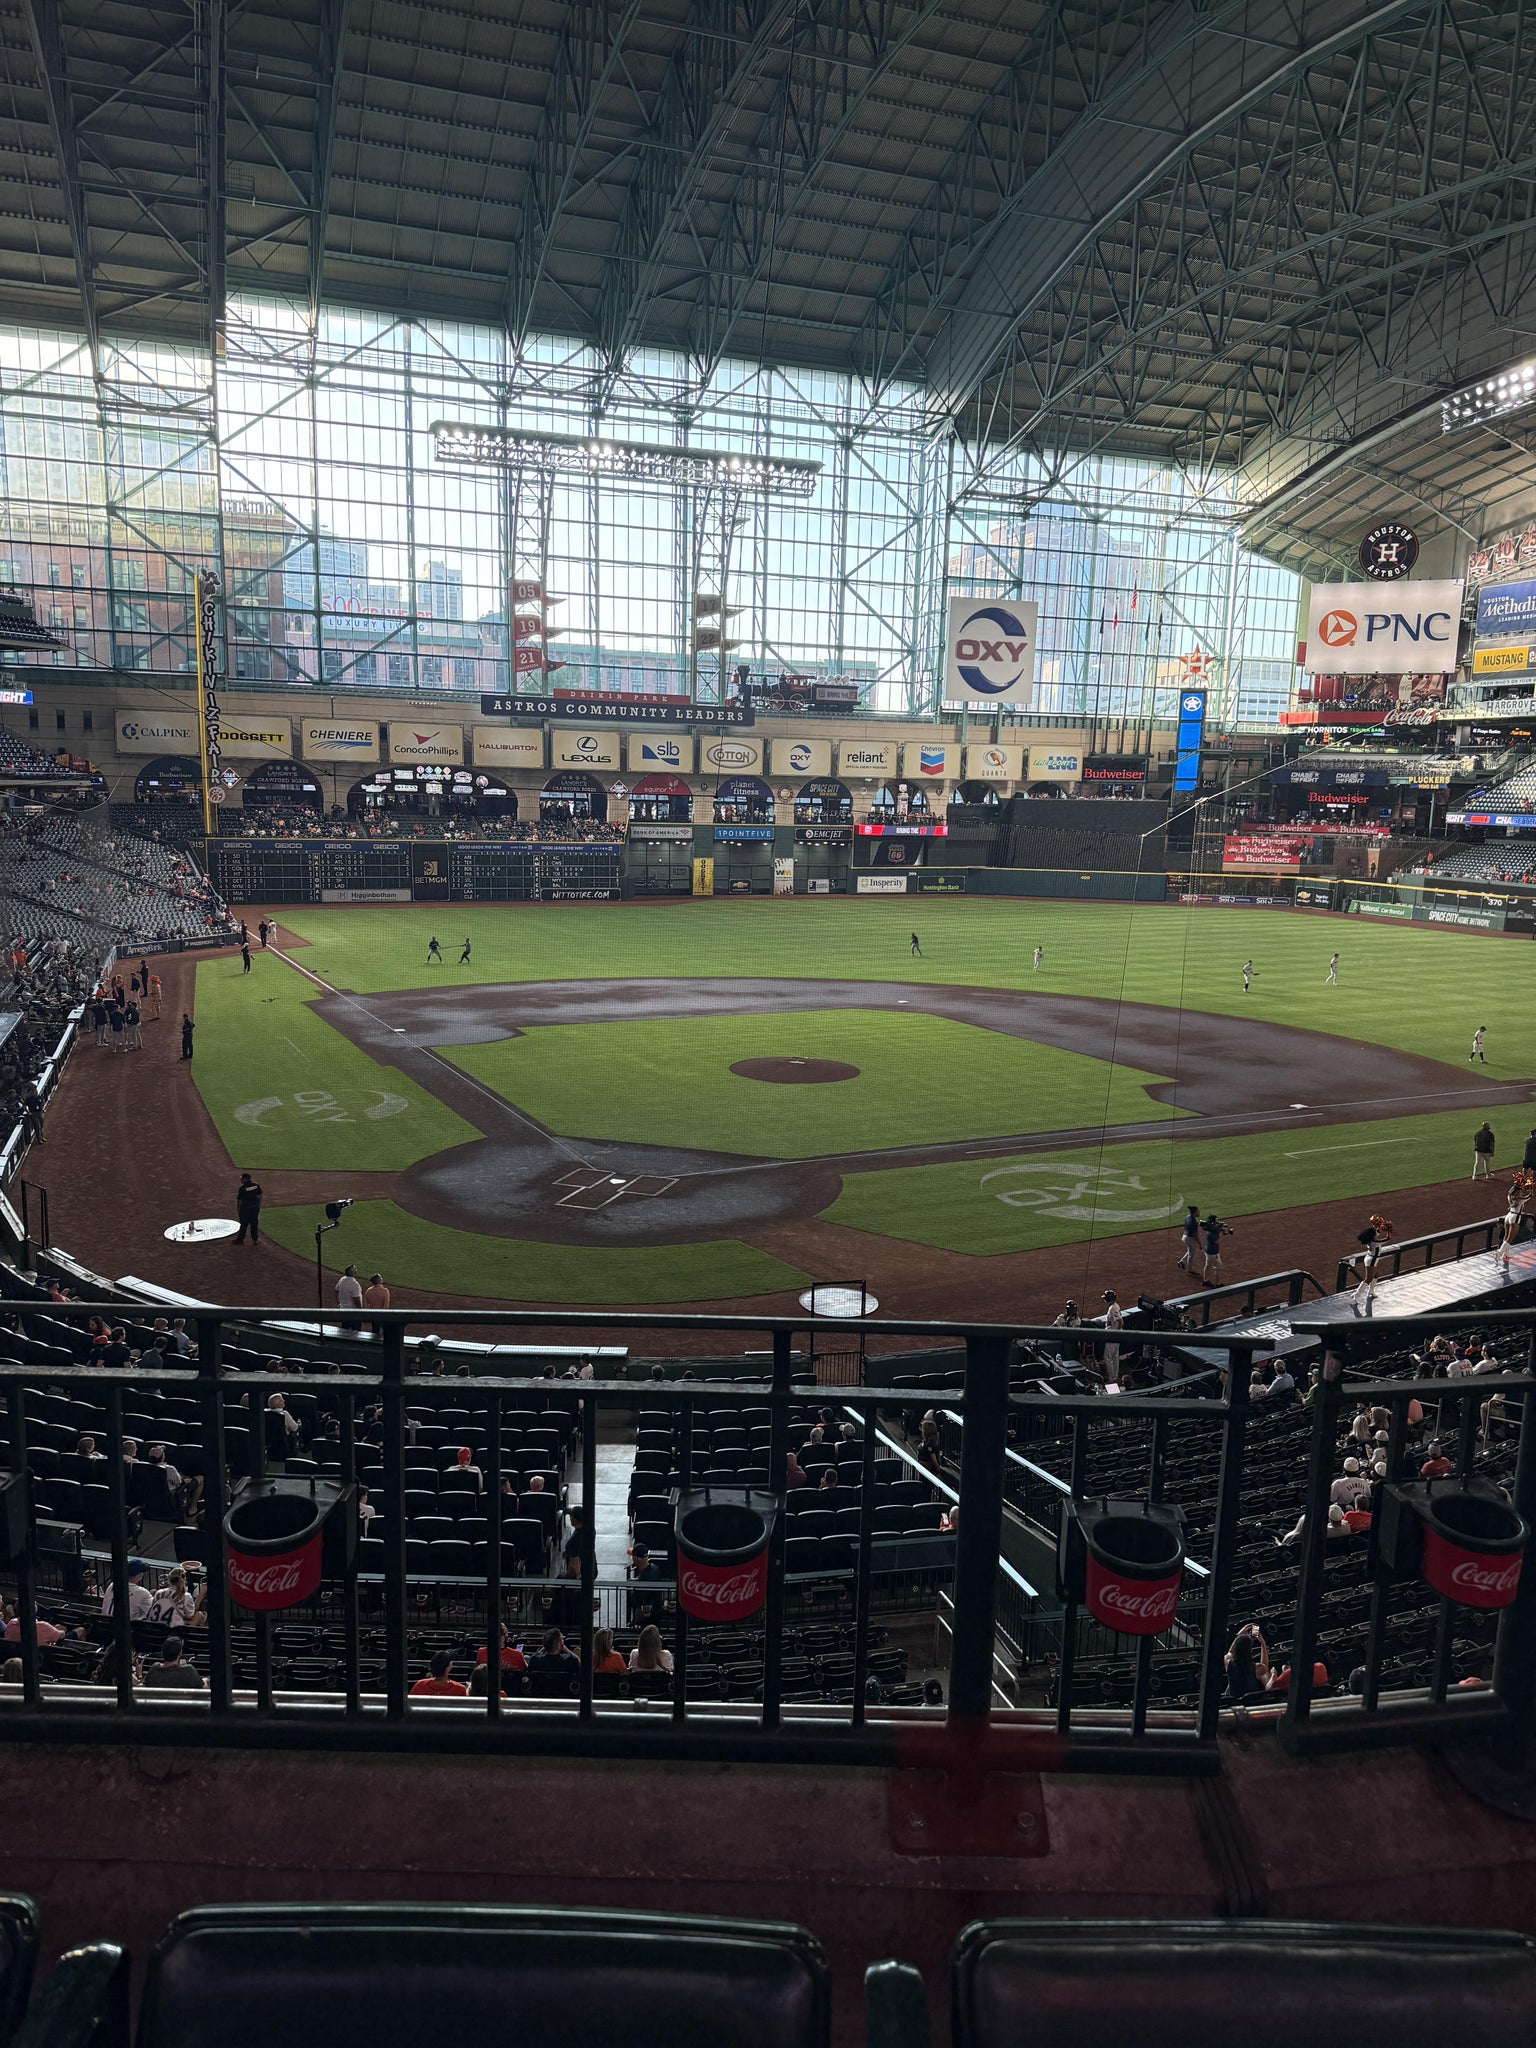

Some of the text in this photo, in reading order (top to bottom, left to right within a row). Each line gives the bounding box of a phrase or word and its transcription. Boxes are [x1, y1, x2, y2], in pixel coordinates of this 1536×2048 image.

[1368, 525, 1413, 542] HOUSTON
[1378, 543, 1399, 562] H
[1495, 540, 1511, 558] 40
[1470, 552, 1486, 569] 32
[1367, 563, 1408, 577] ASTROS
[519, 585, 535, 598] 05
[1483, 595, 1509, 604] HOUSTON
[329, 619, 377, 629] LUXURY
[520, 620, 536, 632] 19
[1364, 612, 1451, 643] PNC
[700, 633, 715, 644] 22
[956, 638, 1028, 663] OXY
[520, 653, 535, 665] 21
[1482, 652, 1524, 667] MUSTANG
[570, 691, 669, 703] DAIKIN PARK
[493, 699, 744, 722] ASTROS COMMUNITY LEADERS
[1383, 708, 1436, 727] Coca-Cola
[140, 727, 190, 739] CALPINE
[309, 730, 373, 741] CHENIERE
[1307, 726, 1349, 734] HORNITOS
[219, 733, 284, 743] DOGGETT
[394, 744, 459, 759] ConocoPhillips
[479, 743, 537, 751] HALLIBURTON
[657, 742, 680, 757] slb
[207, 723, 221, 785] FAIR
[561, 753, 612, 764] LEXUS
[713, 750, 751, 765] COTTON
[847, 751, 885, 764] reliant
[1047, 756, 1078, 771] LNG
[159, 771, 192, 779] Budweiser
[266, 770, 298, 778] LANDRY'S
[1083, 768, 1145, 780] Budweiser
[1408, 776, 1450, 784] PLUCKERS
[730, 780, 756, 791] planet
[733, 786, 760, 796] fitness
[810, 783, 841, 793] SPACE CITY
[1308, 791, 1369, 805] Budweiser
[813, 830, 844, 840] EMCJET
[1268, 825, 1312, 833] Budweiser
[1339, 825, 1378, 835] Budweiser
[223, 842, 252, 850] GEICO
[274, 842, 302, 850] GEICO
[372, 843, 400, 851] GEICO
[1251, 837, 1297, 846] Budweiser
[890, 851, 902, 859] 66
[1245, 855, 1291, 864] Budweiser
[415, 877, 448, 885] BETMGM
[870, 878, 904, 888] Insperity
[351, 892, 397, 900] Higginbotham
[552, 890, 610, 900] NITTOTIRE.COM
[1487, 898, 1502, 907] 370
[1360, 904, 1380, 914] National
[1389, 908, 1405, 917] Rental
[1428, 912, 1445, 923] SPACE
[1445, 913, 1459, 923] CITY
[126, 943, 163, 956] AmegyBank
[293, 1090, 357, 1123] OXY
[994, 1175, 1151, 1207] OXY
[227, 1558, 304, 1593] Coca-Cola
[682, 1568, 760, 1605] Coca-Cola
[1099, 1582, 1179, 1618] Coca-Cola
